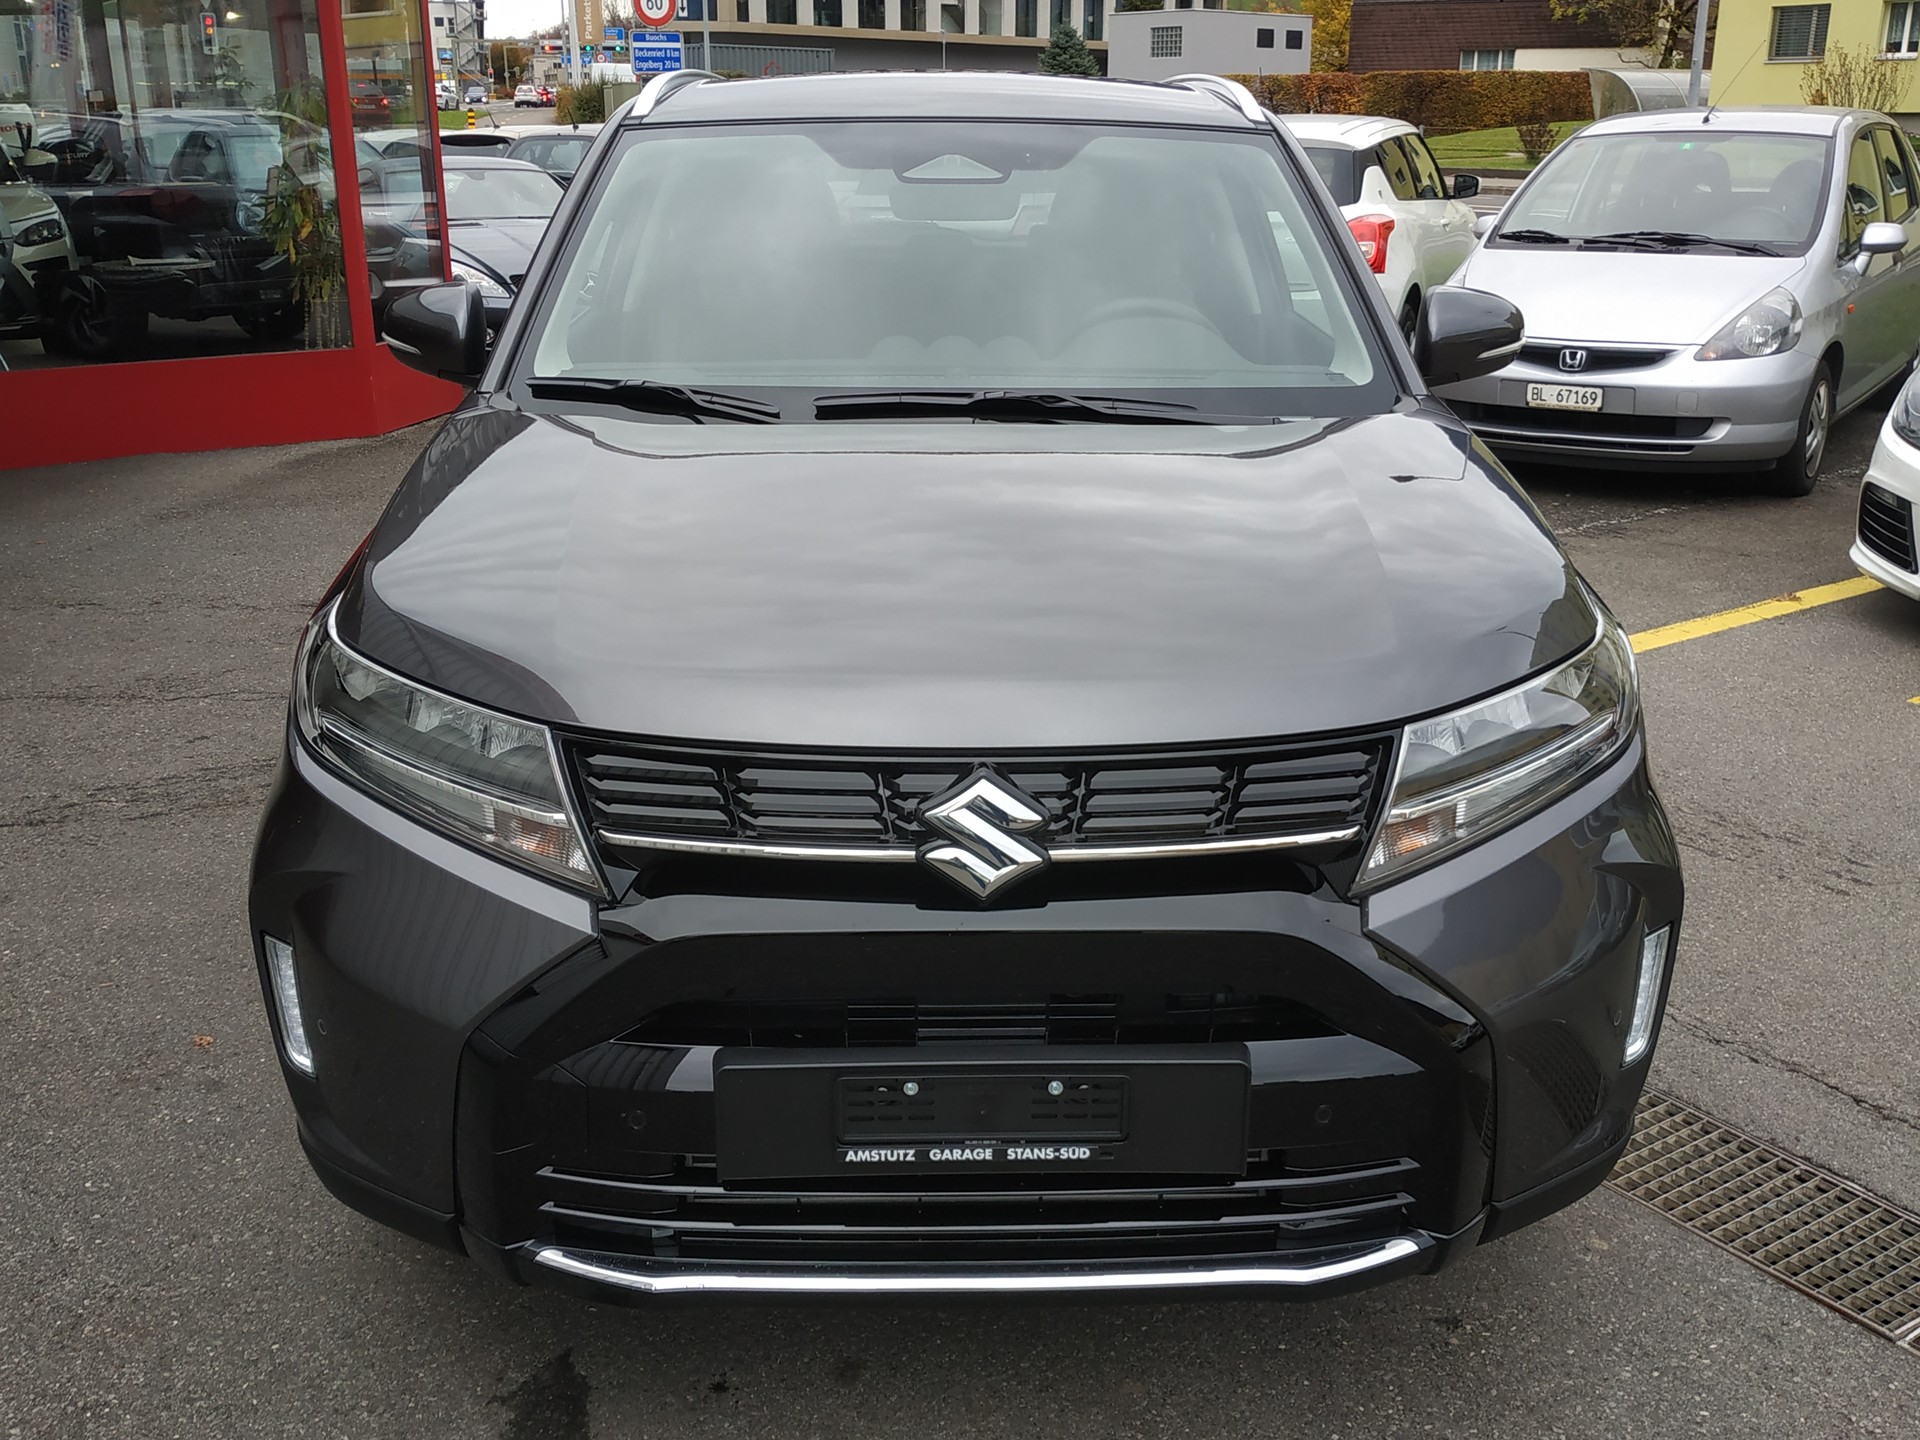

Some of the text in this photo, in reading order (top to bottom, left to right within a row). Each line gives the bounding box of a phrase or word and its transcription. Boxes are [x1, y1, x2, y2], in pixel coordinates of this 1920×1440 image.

[583, 0, 592, 39] Parket
[635, 49, 665, 58] Beckenried
[666, 49, 671, 57] 8
[635, 60, 663, 70] Engelberg
[1556, 388, 1598, 405] 67169
[845, 1146, 1091, 1161] AMSTUTZ GARAGE STANS-SÜD
